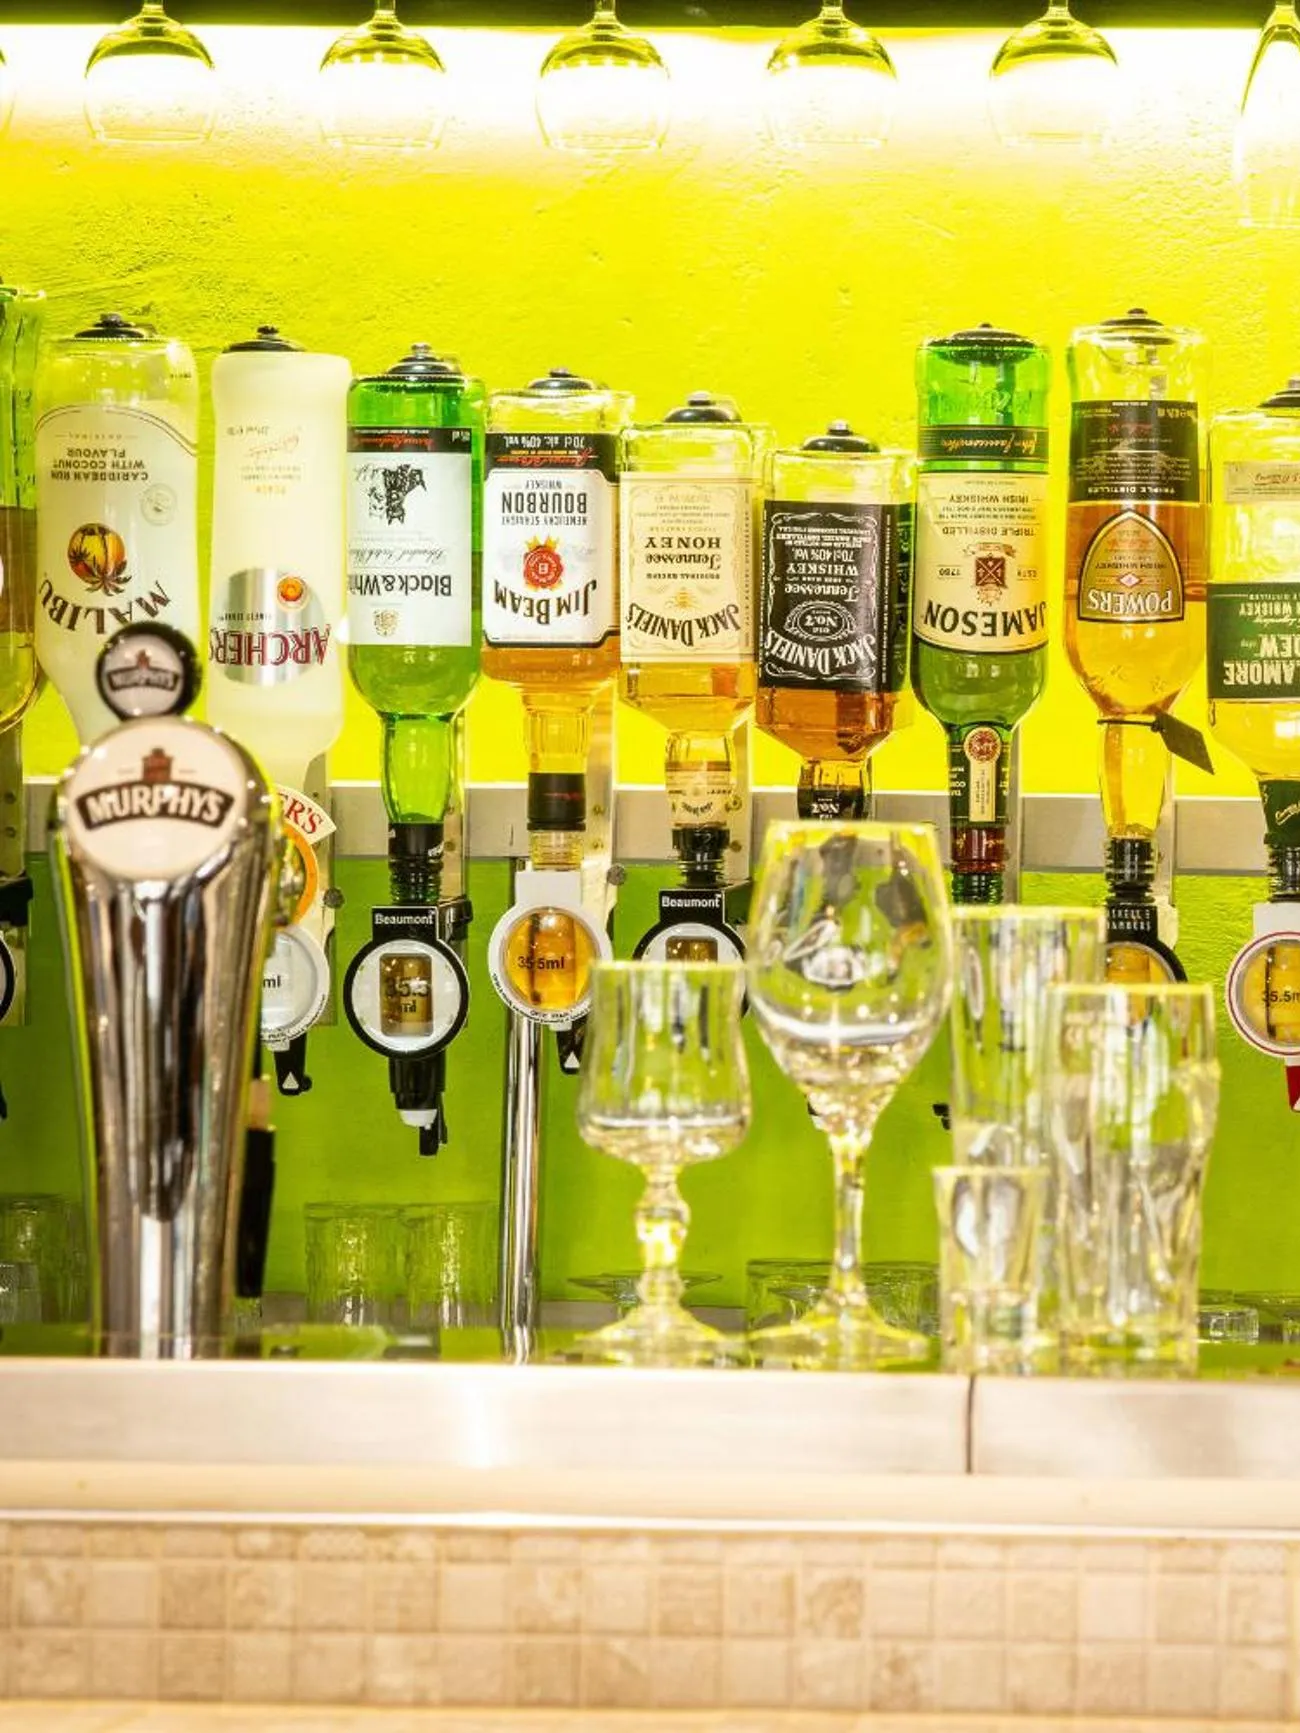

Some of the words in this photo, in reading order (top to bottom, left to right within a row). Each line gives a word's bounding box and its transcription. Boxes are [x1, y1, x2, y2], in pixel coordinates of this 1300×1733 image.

[67, 448, 126, 458] FLAVOUR
[112, 460, 145, 469] WITH
[525, 479, 562, 490] WHISKEY
[501, 492, 587, 514] BOURBON
[1001, 495, 1029, 504] IRISH
[941, 527, 998, 536] DISTILLED
[1000, 527, 1035, 536] TRIPLE
[644, 536, 721, 549] HONEY
[645, 553, 721, 571] Tennessee
[786, 562, 859, 577] WHISKEY
[556, 580, 597, 617] JIM
[784, 584, 860, 602] Tennessee
[1087, 588, 1174, 614] POWERS
[38, 579, 171, 635] MALIBU
[494, 580, 551, 626] BEAM
[1239, 602, 1292, 616] WHISKEY
[625, 603, 694, 647] DANIEL'S
[693, 604, 741, 640] JACK
[922, 600, 1047, 637] JAMESON
[764, 629, 830, 675] DANIEL'S
[832, 634, 878, 669] JACK
[661, 896, 721, 908] Beaumont
[374, 913, 434, 926] Beaumont
[517, 955, 566, 970] 355ml
